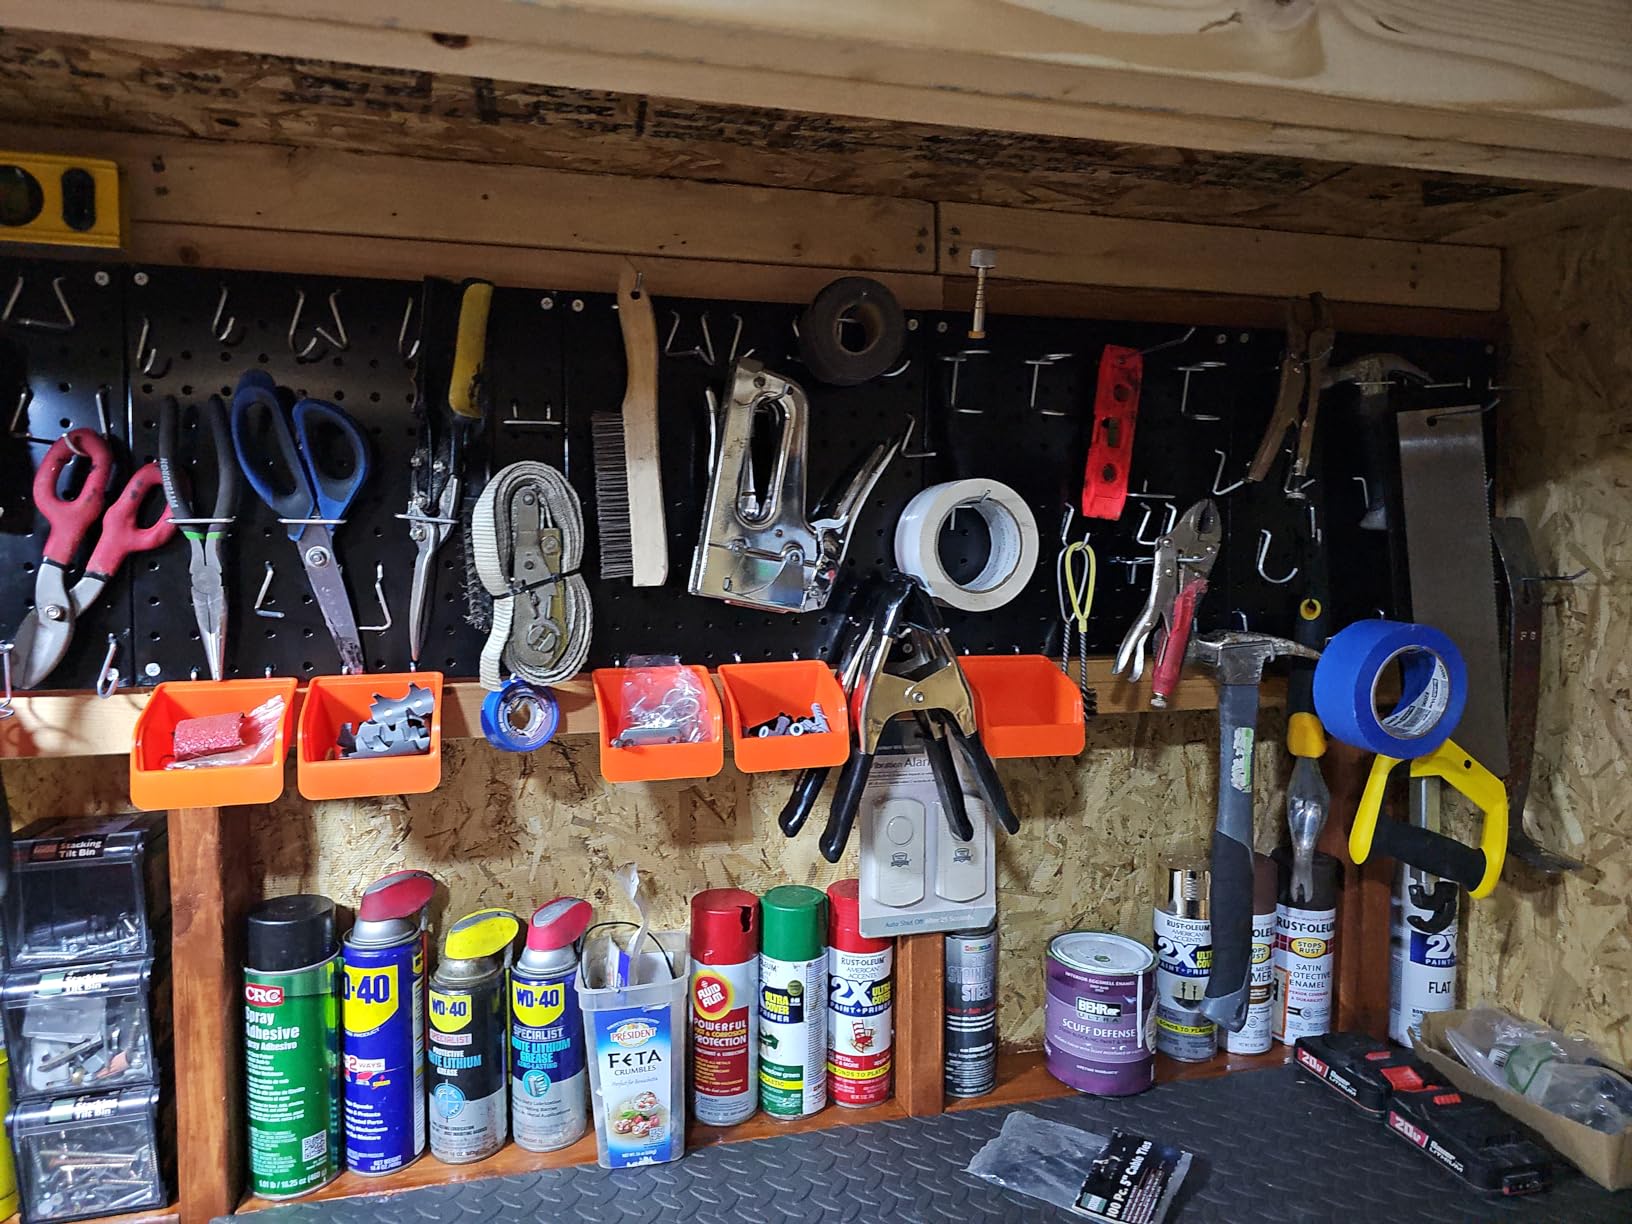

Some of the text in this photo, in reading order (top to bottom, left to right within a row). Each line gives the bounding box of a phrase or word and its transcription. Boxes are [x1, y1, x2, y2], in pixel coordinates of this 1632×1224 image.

[60, 840, 103, 850] Stacking
[58, 848, 96, 858] Tilt Bin
[1166, 919, 1210, 931] RUST-OLEUM
[1173, 929, 1204, 937] AMERICAN
[1158, 936, 1198, 968] 2X
[1297, 941, 1322, 949] STOPS
[1299, 946, 1321, 954] RUST
[1425, 934, 1457, 959] 2X
[841, 955, 884, 966] RUST-OLEUM
[1295, 963, 1322, 971] SATIN
[847, 966, 880, 974] AMERICAN
[1065, 972, 1088, 982] INTERIOR
[1089, 977, 1115, 986] EGGSHELL
[1289, 979, 1325, 989] ENAMEL
[246, 986, 282, 1003] CRC
[697, 983, 721, 1001] FLUID
[830, 976, 874, 1007] 2X
[1429, 981, 1452, 994] FLAT
[516, 987, 560, 1008] WD-40
[702, 992, 723, 1008] FILM
[765, 990, 790, 1006] ULTRA
[432, 998, 467, 1016] WD-40
[765, 1001, 790, 1016] COVER
[1078, 999, 1108, 1016] BEHR
[1079, 1013, 1119, 1023] ULTRA
[514, 1026, 564, 1040] SPECIALIST
[612, 1028, 656, 1041] PRÉSIDENT
[1062, 1018, 1136, 1038] SCUFF DEFENSE
[349, 1056, 383, 1071] 2 WAYS
[443, 1055, 482, 1069] LITHIUM
[520, 1051, 554, 1064] GREASE
[614, 1065, 657, 1076] CRUMBLES
[1329, 1076, 1357, 1097] LITHIUM
[1429, 1147, 1464, 1173] LITHIUM
[1106, 1140, 1152, 1218] 100 Pc. 5" Cable Ties
